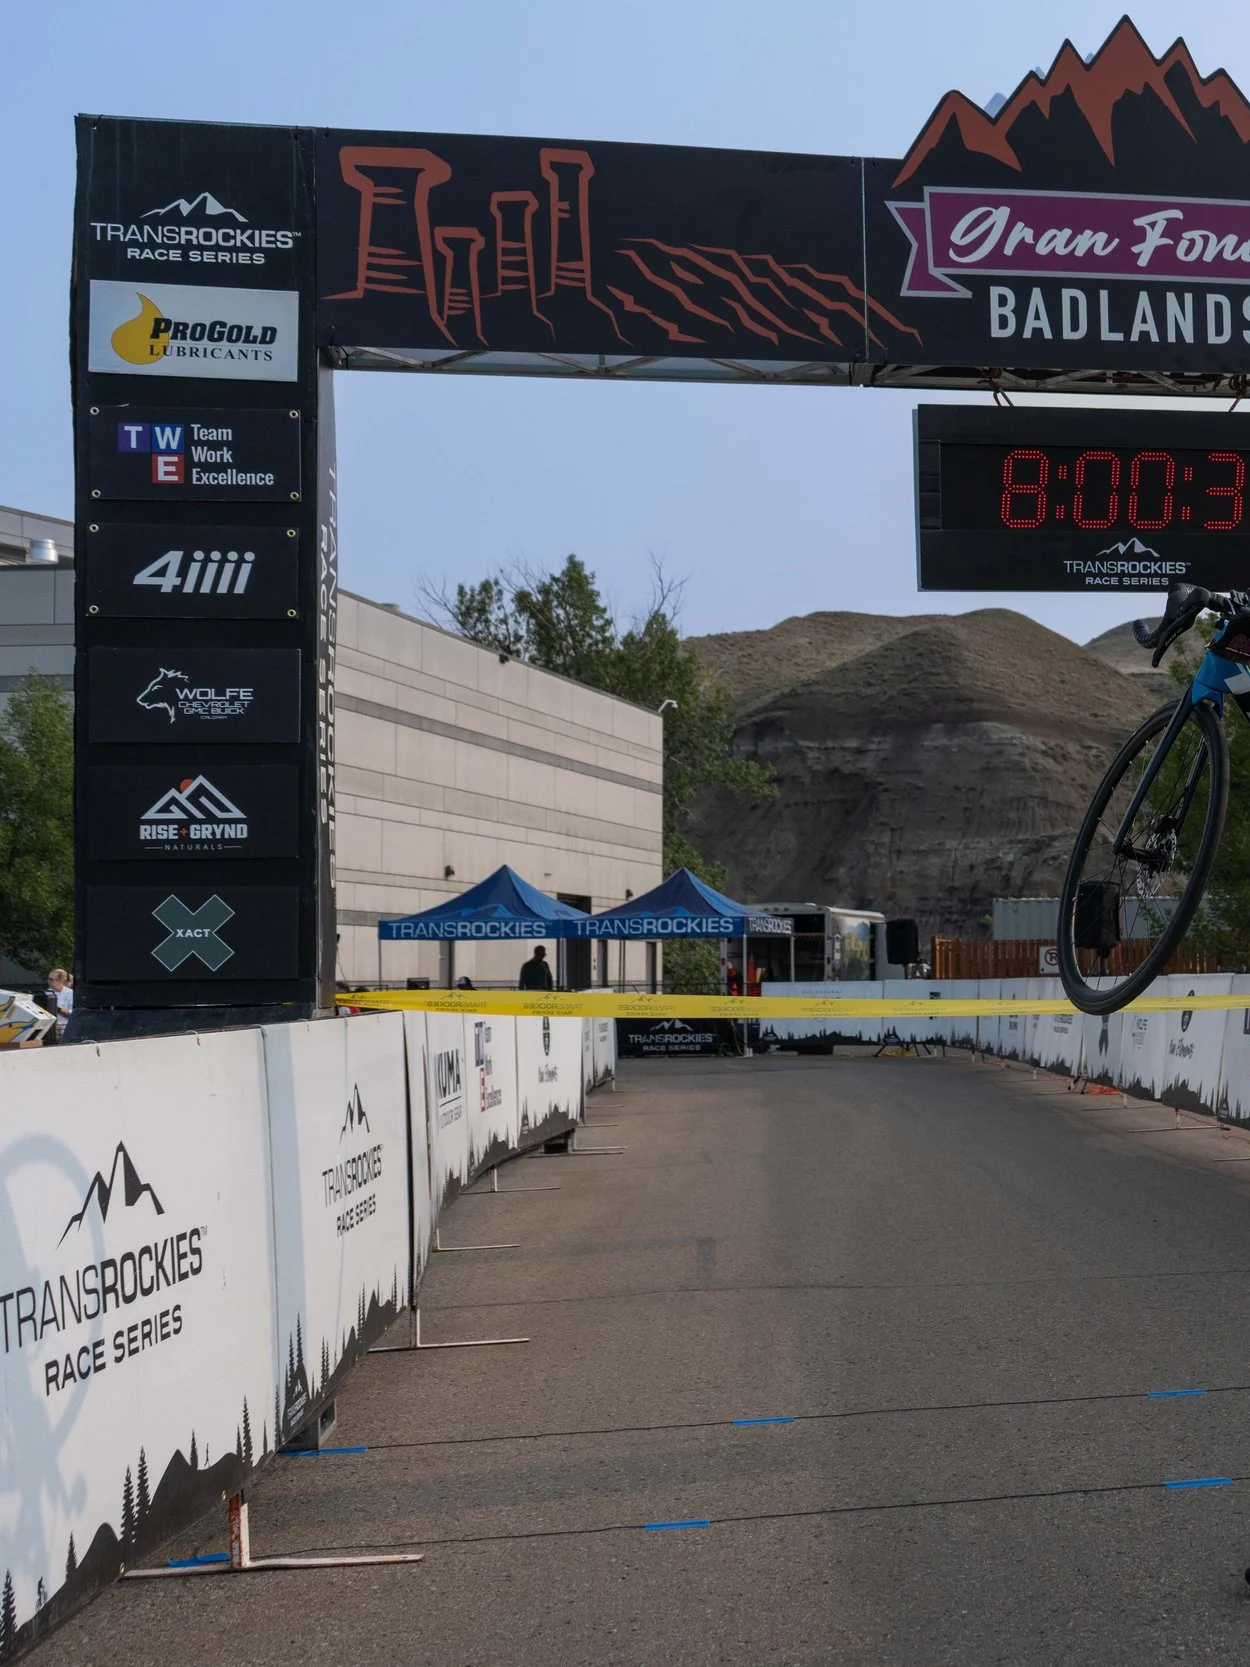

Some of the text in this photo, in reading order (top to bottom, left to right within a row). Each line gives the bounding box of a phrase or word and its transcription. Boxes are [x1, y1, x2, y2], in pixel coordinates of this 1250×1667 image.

[127, 248, 265, 264] RACE SERIES
[149, 345, 273, 361] LUBRICANTS
[191, 424, 232, 441] Team
[191, 447, 232, 463] Work
[192, 469, 274, 485] Excellence
[133, 551, 255, 594] 4iiii
[1085, 577, 1169, 586] RACE SERIES
[319, 524, 328, 824] RACE SERIES
[176, 688, 254, 700] WOLFE
[165, 843, 223, 851] NATURALS
[176, 929, 211, 938] XACT
[337, 1194, 376, 1238] RACE SERIES
[45, 1304, 183, 1396] RACE SERIES
